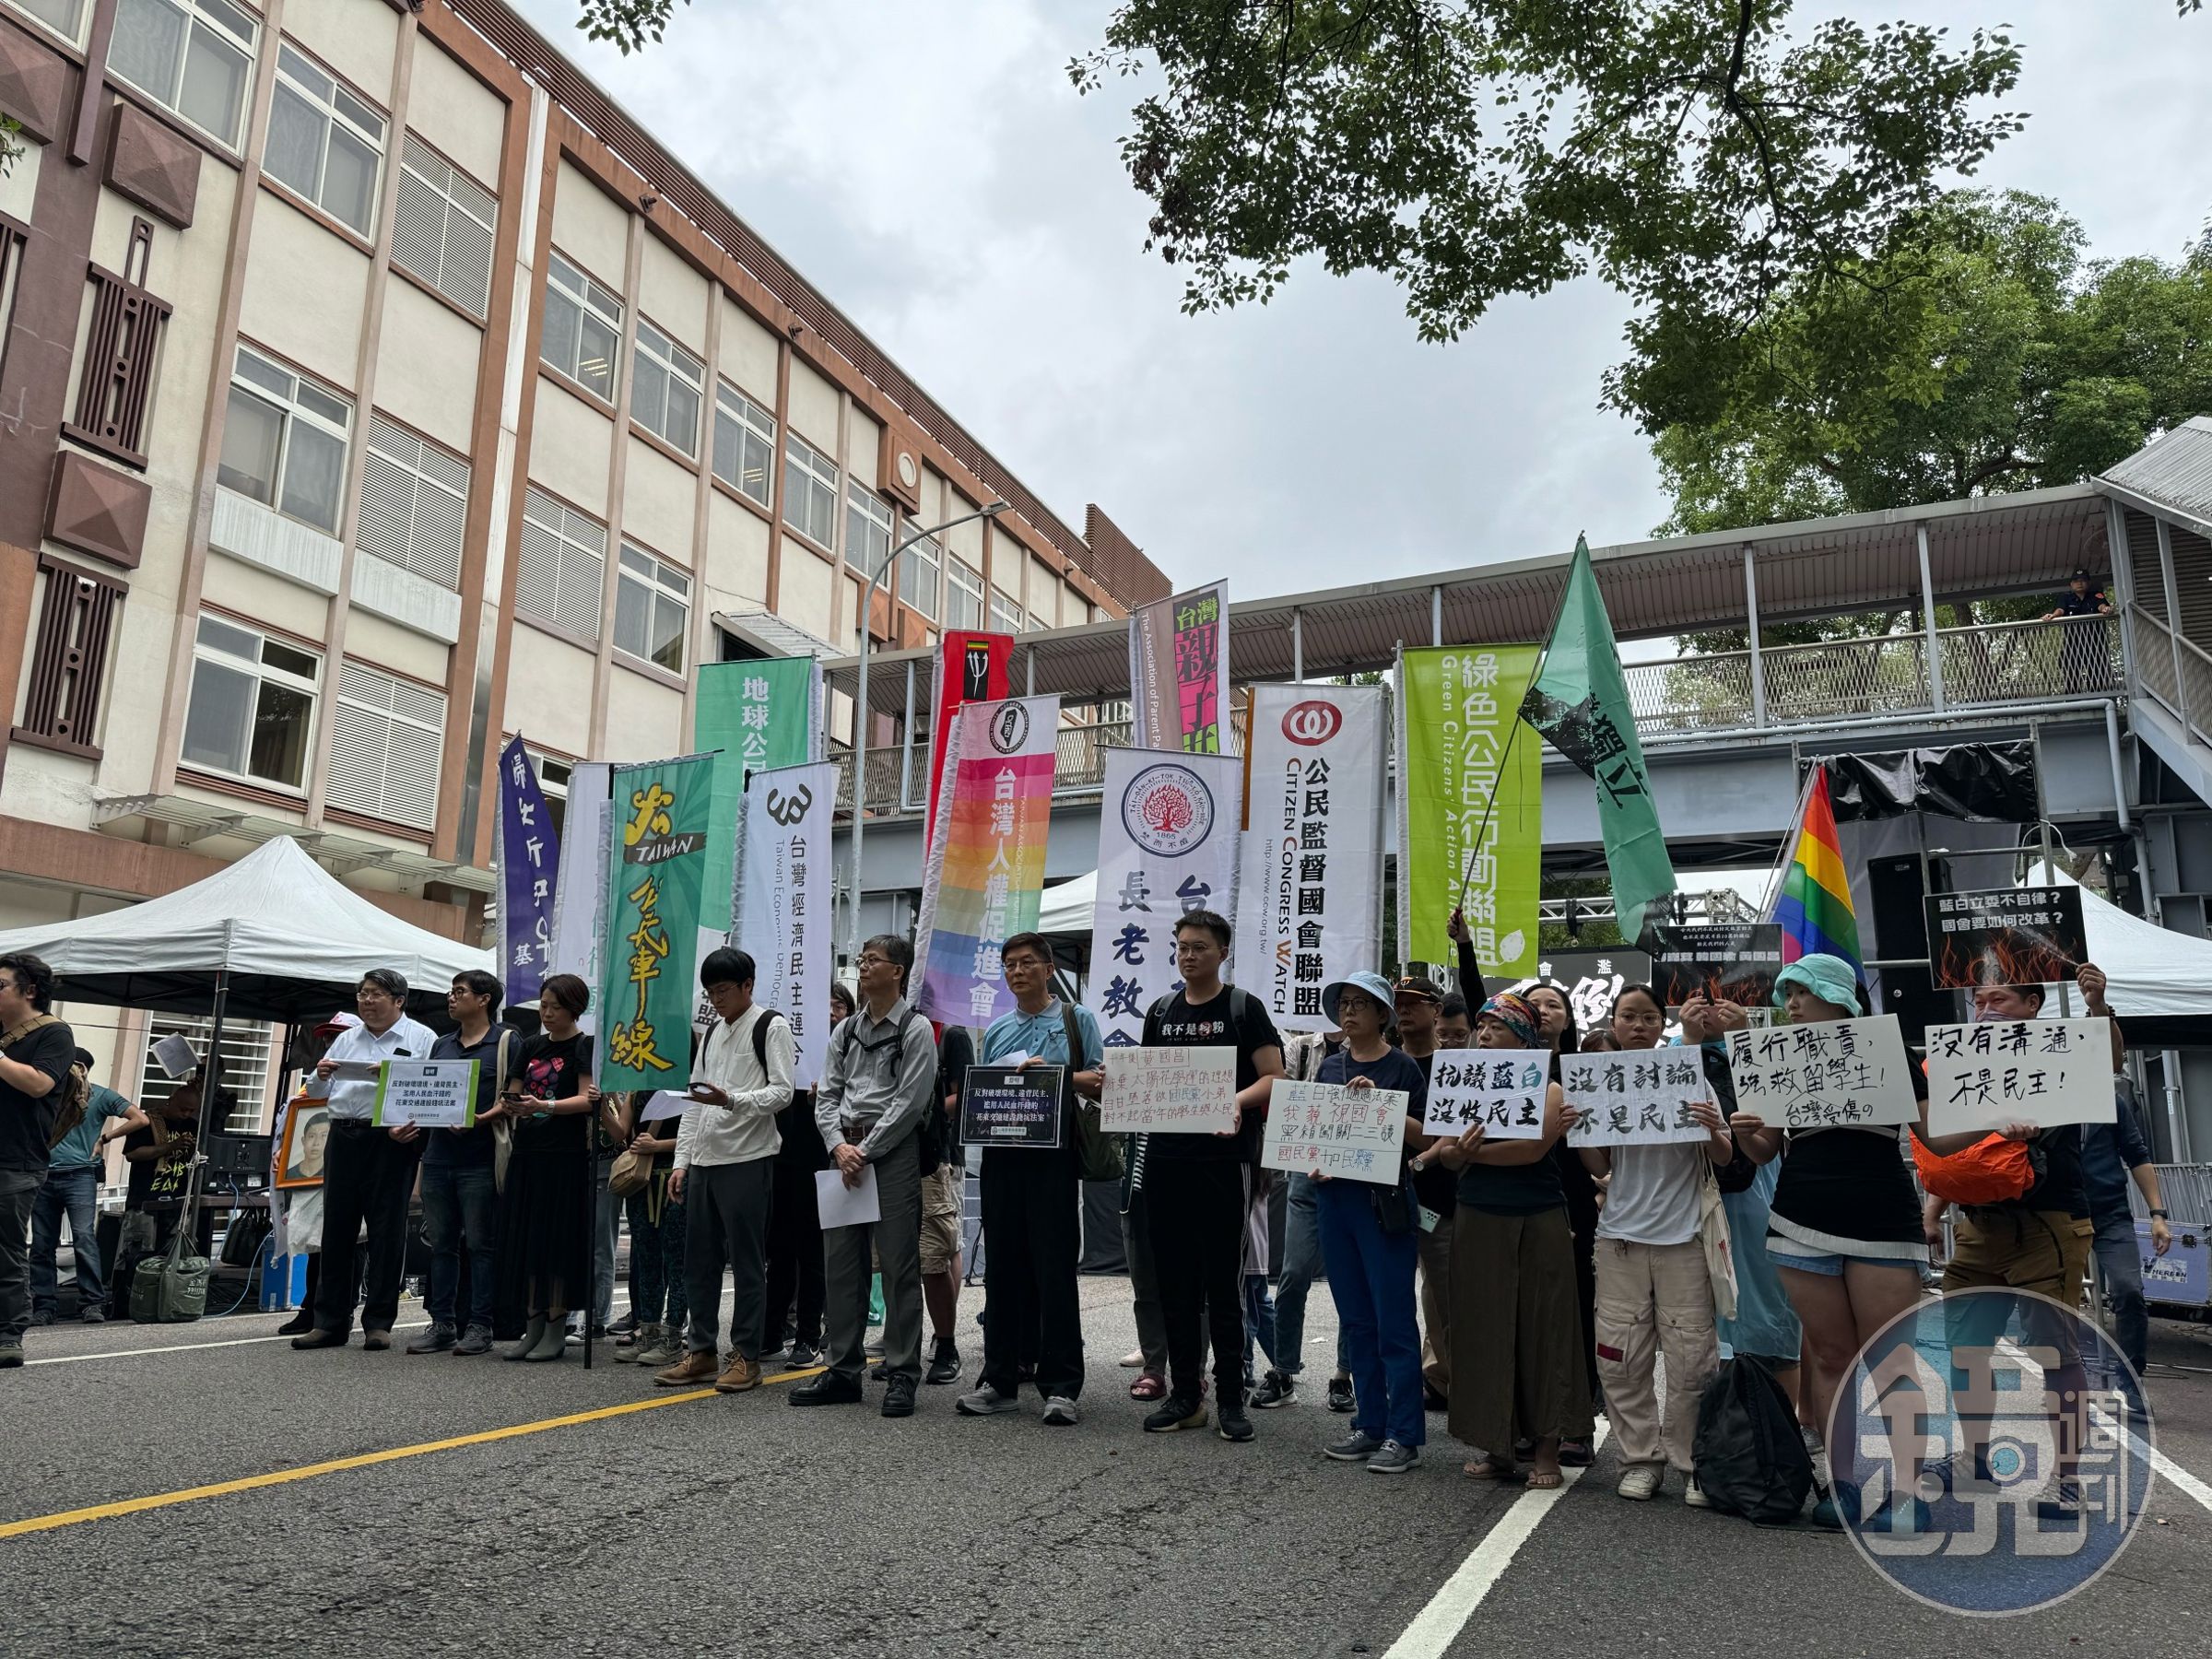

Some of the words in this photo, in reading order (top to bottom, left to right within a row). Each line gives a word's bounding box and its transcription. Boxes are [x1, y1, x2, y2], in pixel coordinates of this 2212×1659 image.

[1177, 597, 1218, 630] 台灣
[1146, 633, 1157, 688] Association
[1149, 689, 1158, 700] of
[1441, 654, 1459, 712] Green
[1150, 701, 1159, 730] Parent
[1441, 720, 1459, 803] Citizens'
[1284, 757, 1302, 831] CITIZEN
[1461, 653, 1500, 967] 綠色公民行動聯盟
[634, 835, 694, 864] TAIWAN
[1157, 831, 1176, 840] 1865
[1444, 807, 1459, 870] Action
[775, 839, 785, 883] Taiwan
[970, 766, 1017, 1018] 台灣人權促進會
[1258, 838, 1274, 956] http://www.ccw.org.tw/
[1277, 835, 1298, 935] CONGRESS
[1292, 757, 1332, 1016] 公民監督國會聯盟
[1938, 890, 2062, 913] 藍白立委不自律？
[1941, 911, 2064, 933] 國會要如何改革？
[1273, 939, 1292, 1015] WATCH
[1434, 1060, 1543, 1092] 抗議藍白
[1567, 1060, 1700, 1094] 沒有討論
[1429, 1096, 1540, 1127] 沒收民主
[1573, 1100, 1703, 1135] 不是民主
